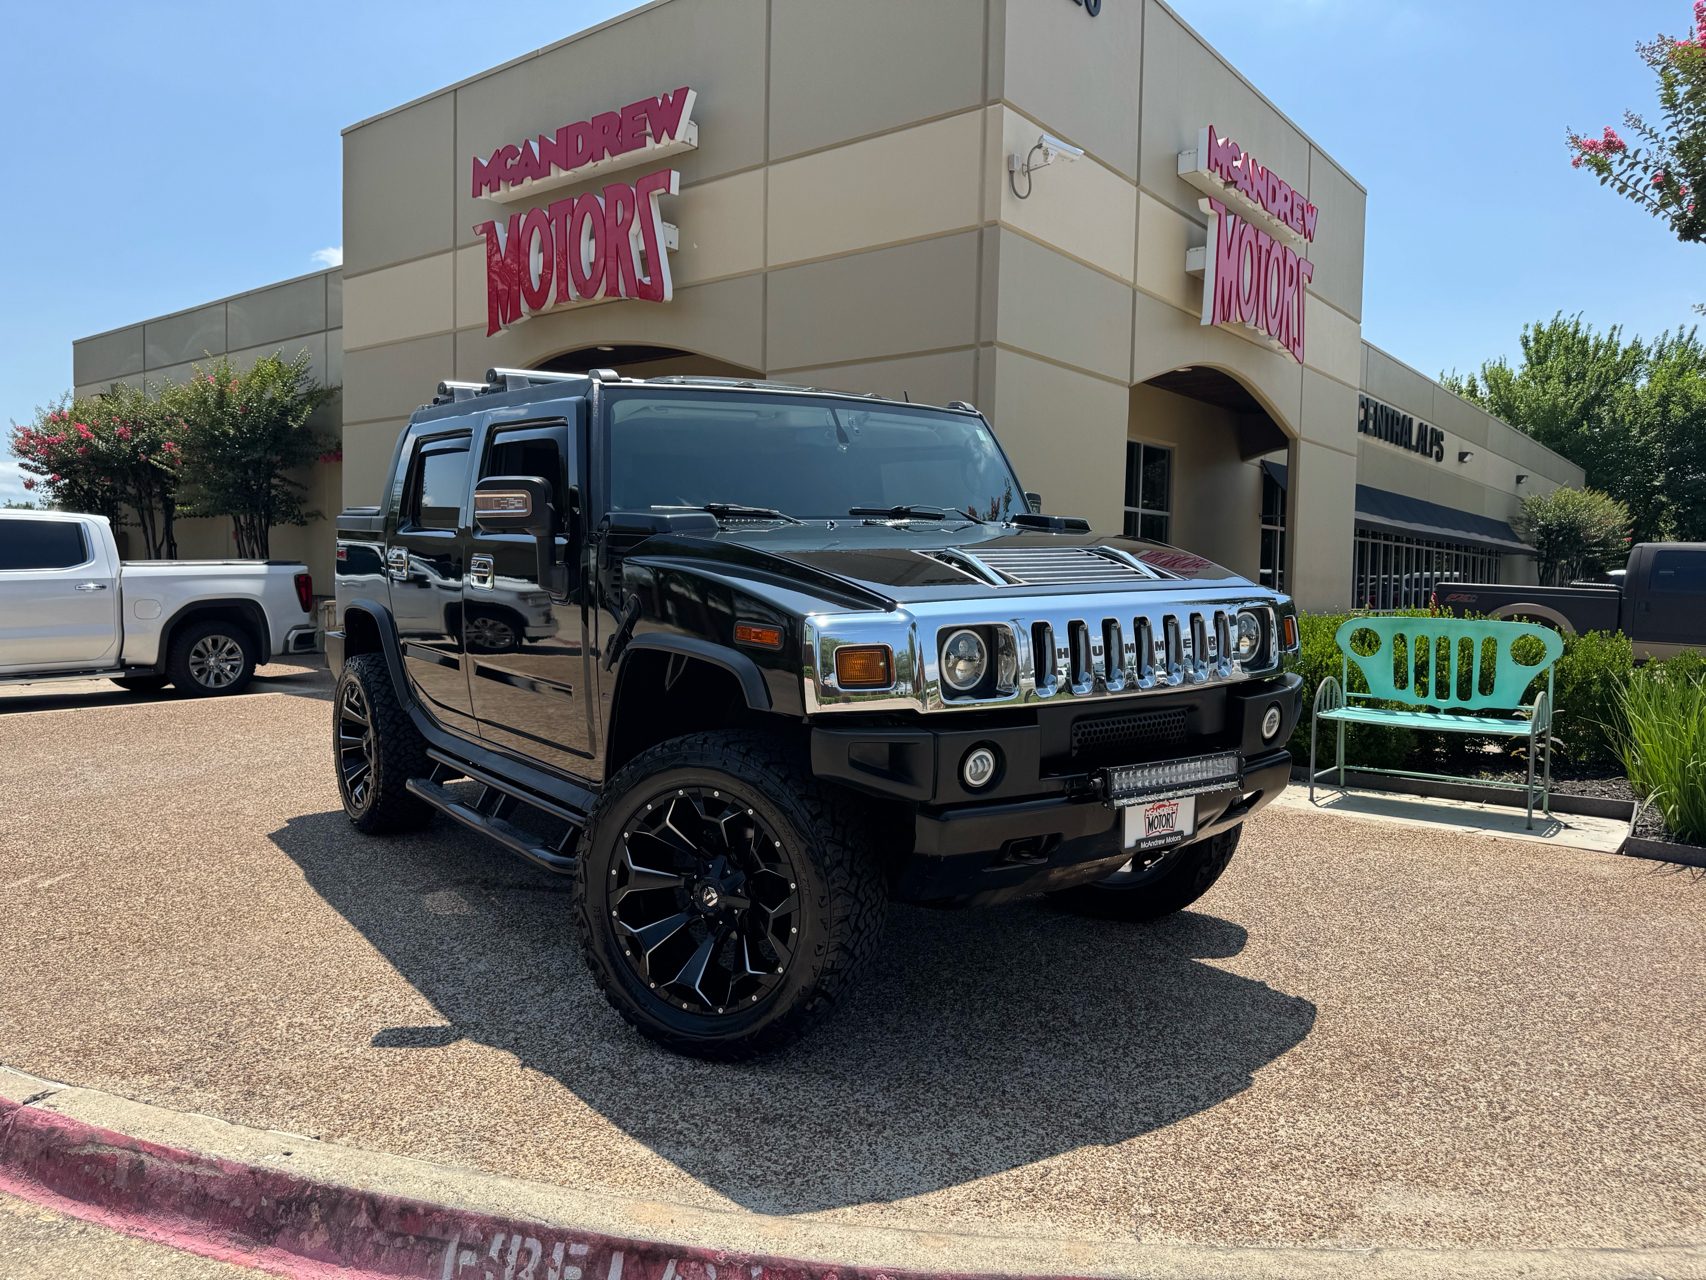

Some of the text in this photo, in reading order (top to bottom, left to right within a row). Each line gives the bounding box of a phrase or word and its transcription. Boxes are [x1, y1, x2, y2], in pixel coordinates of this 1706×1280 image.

[472, 168, 673, 337] MOTORS
[1208, 196, 1314, 365] MOTORS
[1056, 636, 1217, 659] HUMMER
[1146, 811, 1176, 833] MOTORS
[1140, 834, 1182, 849] McAndrew Motors
